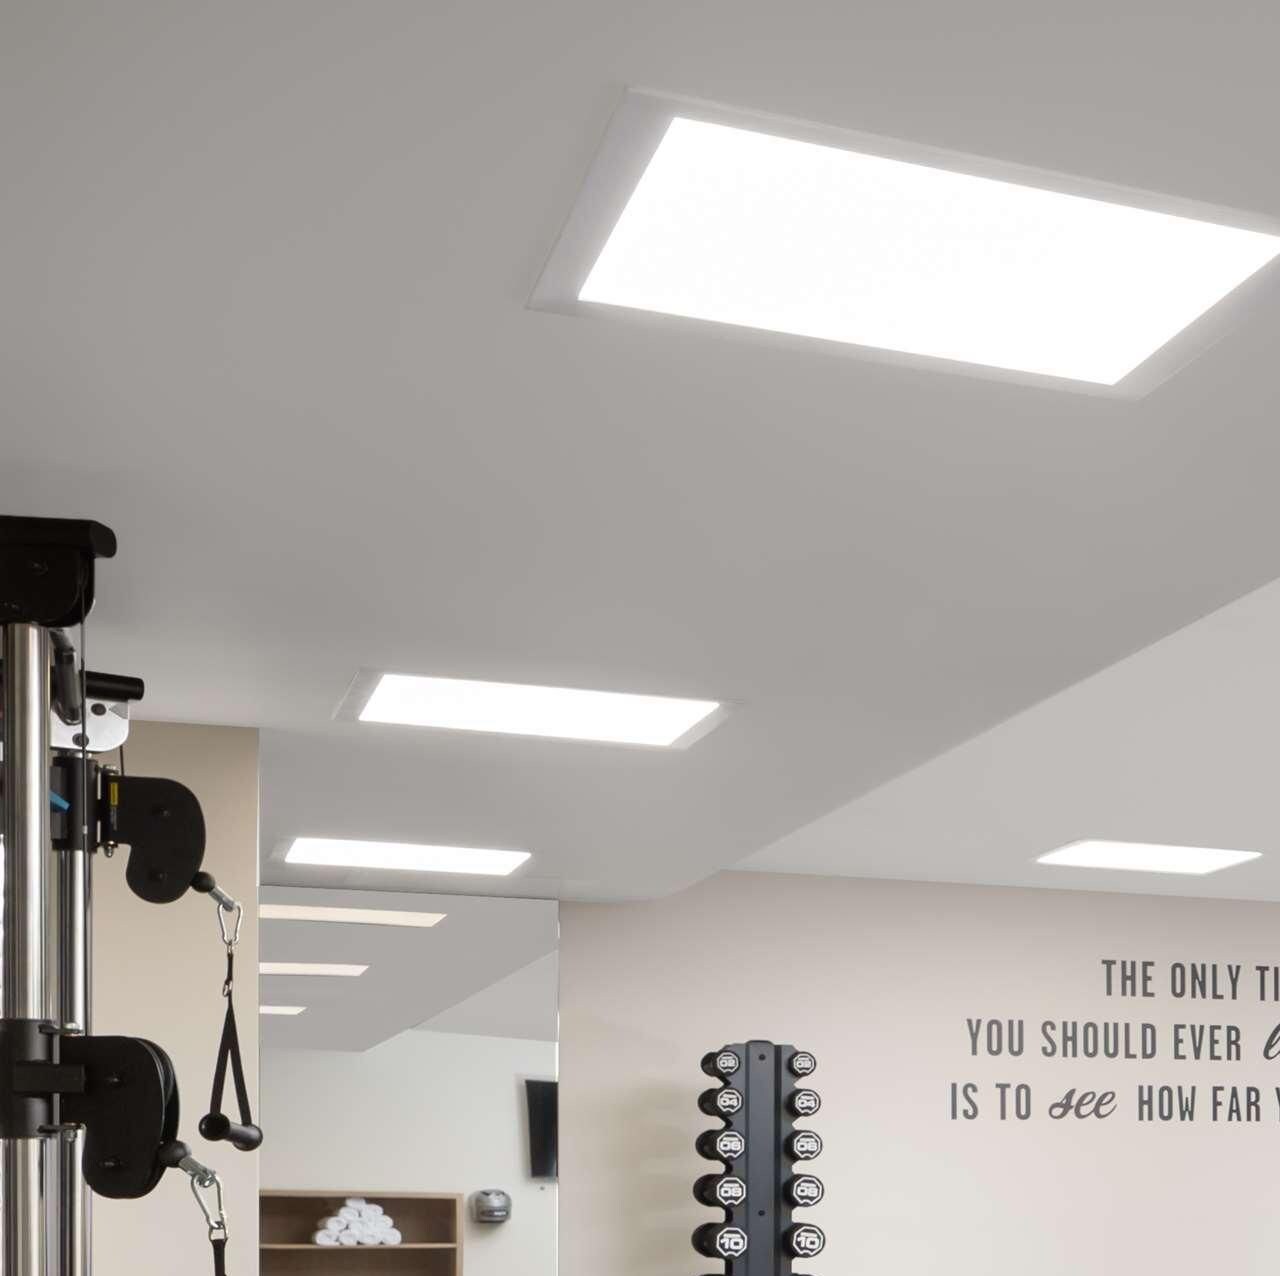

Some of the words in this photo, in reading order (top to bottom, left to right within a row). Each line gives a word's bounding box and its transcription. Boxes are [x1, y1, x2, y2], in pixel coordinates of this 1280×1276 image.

[1101, 959, 1156, 998] THE
[1170, 962, 1241, 1001] ONLY
[966, 1018, 1024, 1057] YOU
[1041, 1020, 1157, 1060] SHOULD
[1173, 1023, 1241, 1061] EVER
[951, 1082, 978, 1120] IS
[995, 1083, 1031, 1121] TO
[1048, 1088, 1117, 1120] see
[1138, 1085, 1196, 1122] HOW
[1212, 1086, 1261, 1122] FAR
[720, 1238, 744, 1250] 10
[797, 1236, 819, 1249] 10
